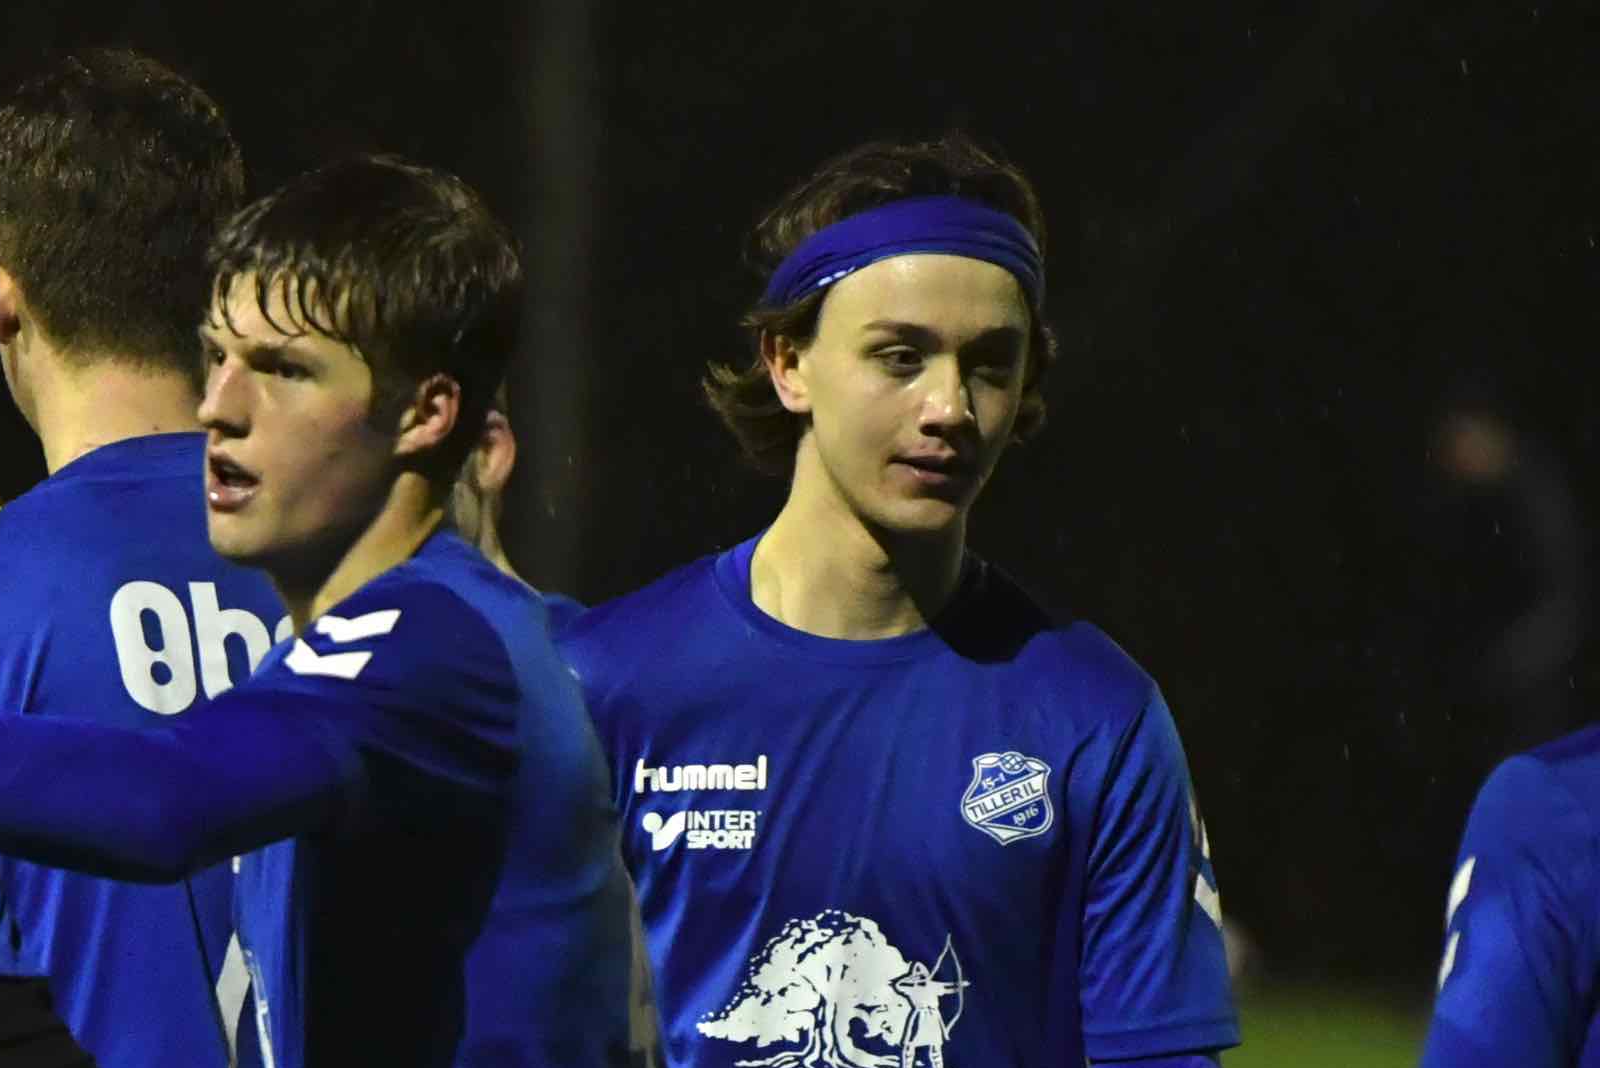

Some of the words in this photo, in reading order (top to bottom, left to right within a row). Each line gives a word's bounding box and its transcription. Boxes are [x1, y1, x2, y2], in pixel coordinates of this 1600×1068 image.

[634, 754, 768, 794] hummel
[968, 787, 1023, 819] TILLER
[1023, 781, 1041, 797] IL
[687, 810, 756, 830] INTER
[686, 829, 756, 850] SPORT
